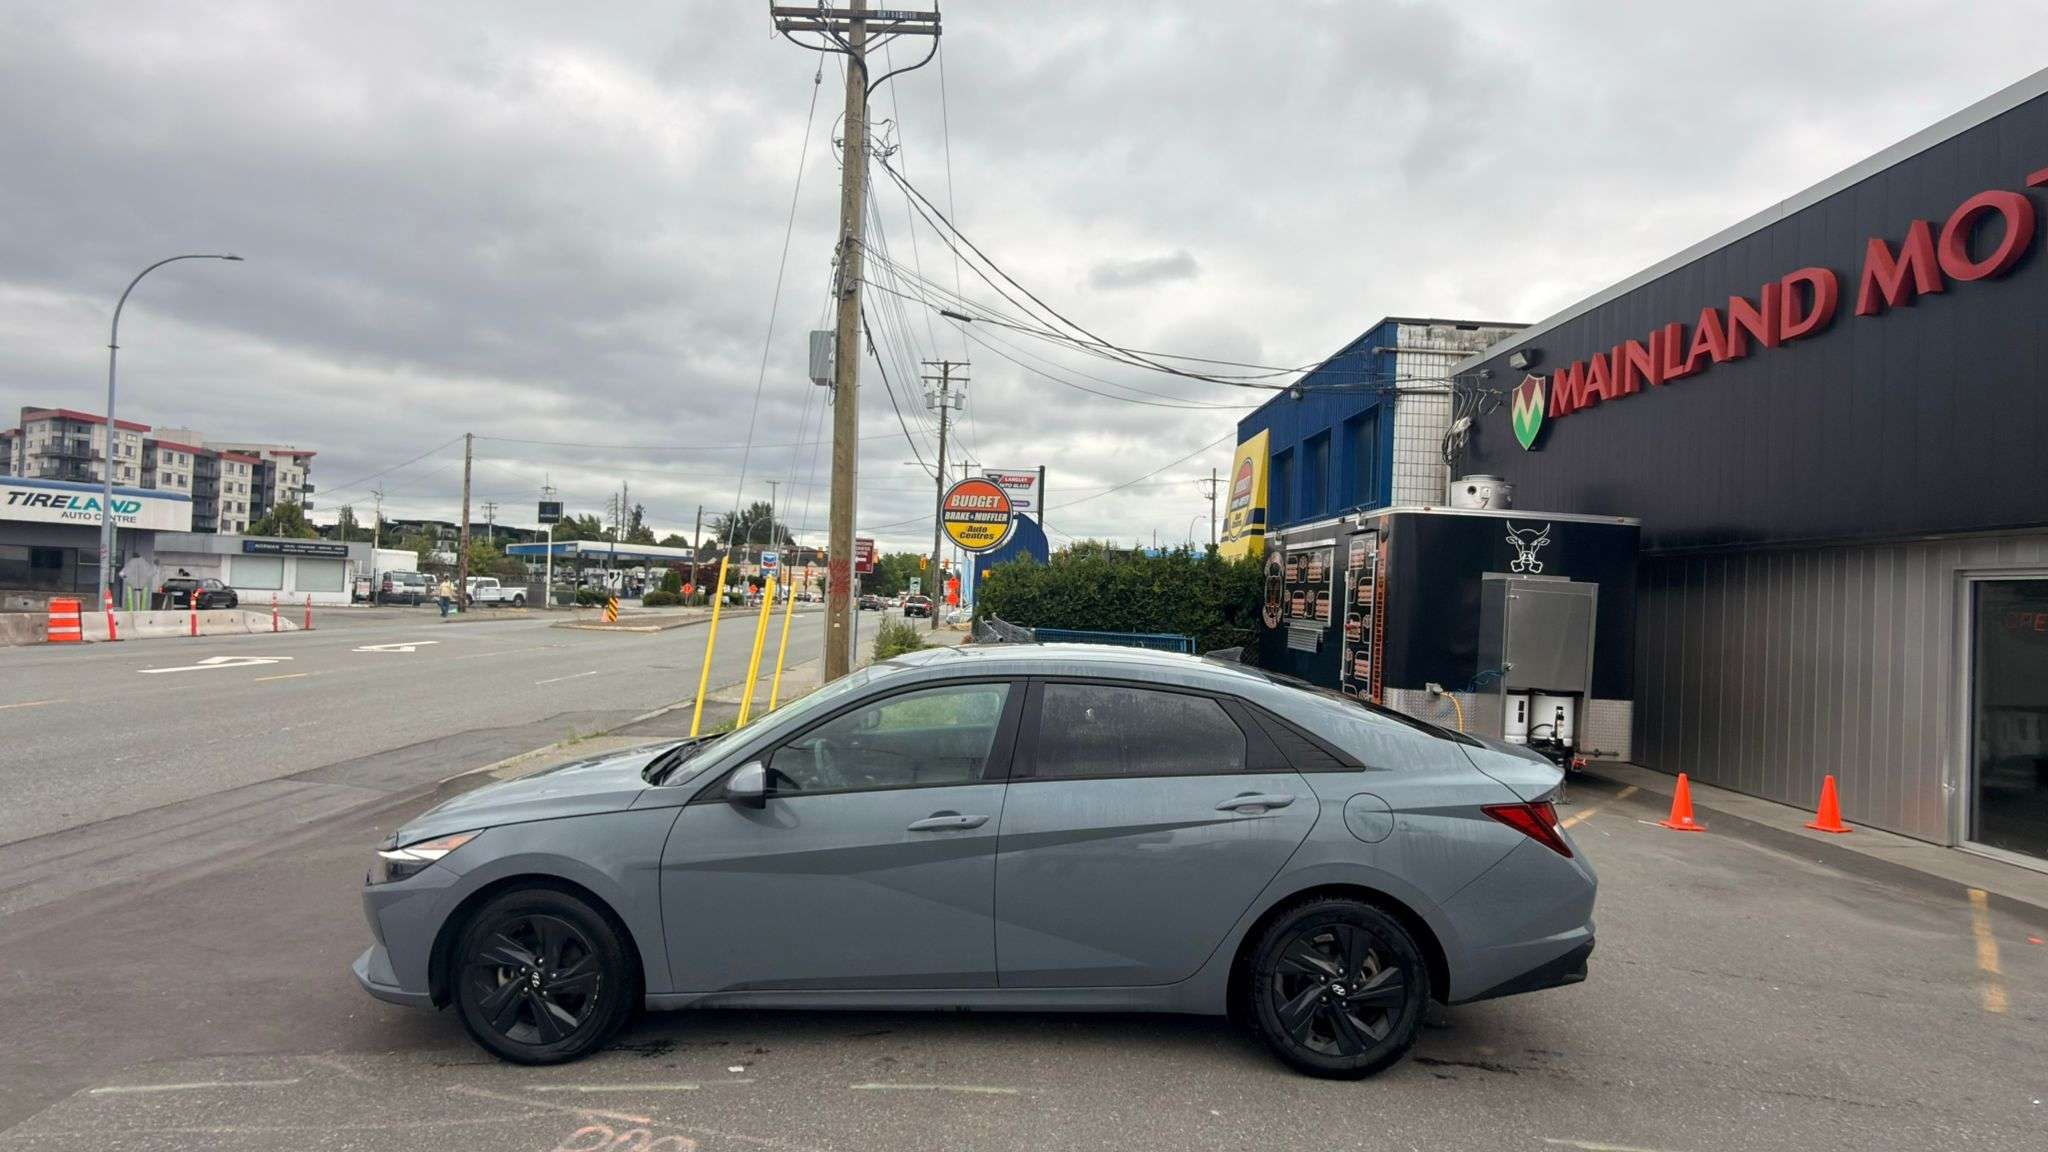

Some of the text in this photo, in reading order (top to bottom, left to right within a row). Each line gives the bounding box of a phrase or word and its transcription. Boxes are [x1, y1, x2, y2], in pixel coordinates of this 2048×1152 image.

[1548, 168, 2048, 418] MAINLAND MO
[951, 494, 1001, 508] BUDGET
[61, 511, 137, 523] AUTO CNTRE
[944, 511, 970, 520] BRAKE
[974, 512, 1008, 521] MUFFLER
[967, 525, 988, 533] Auto
[959, 532, 994, 540] Centres
